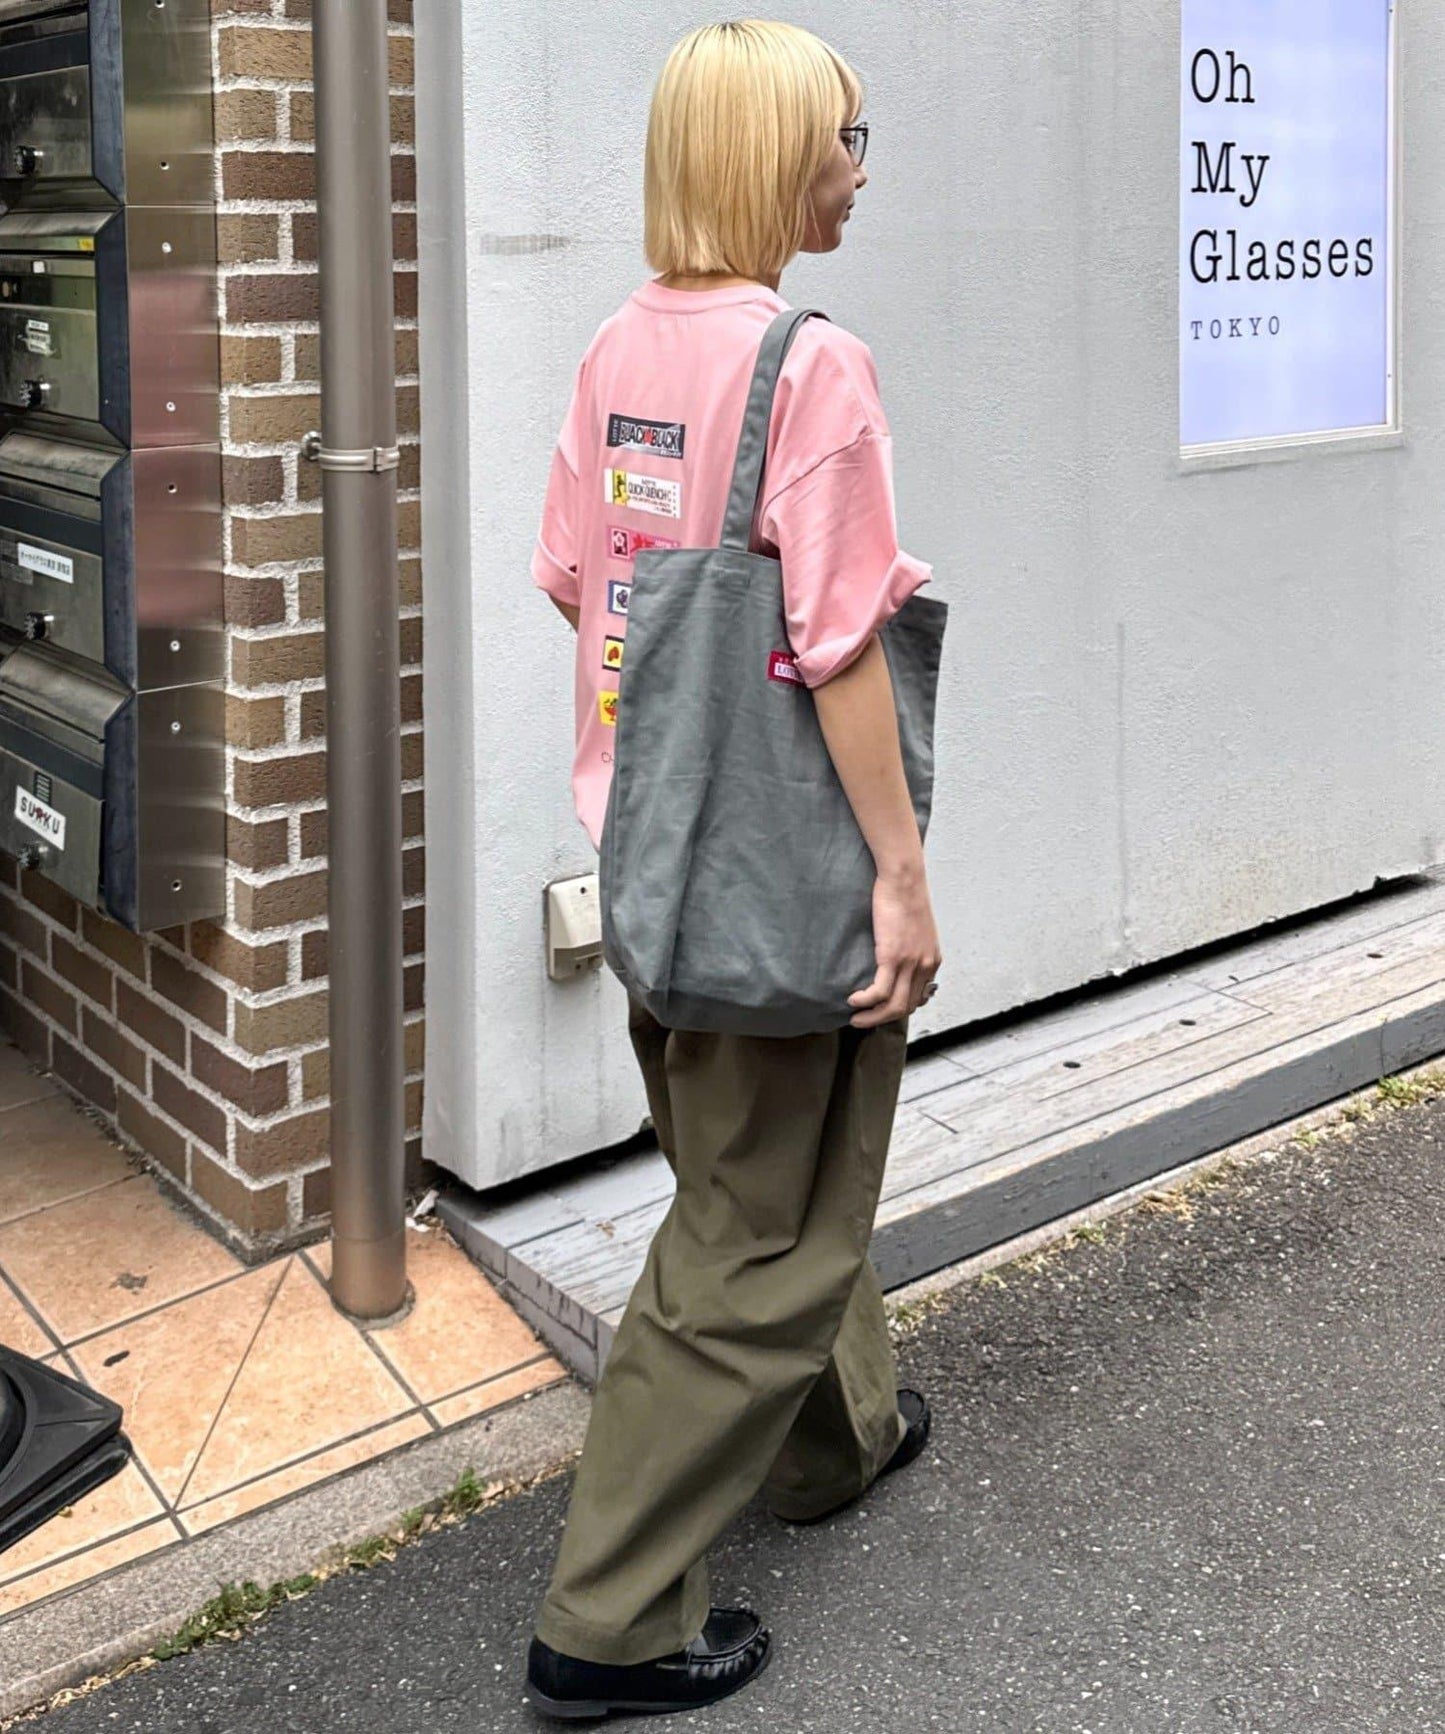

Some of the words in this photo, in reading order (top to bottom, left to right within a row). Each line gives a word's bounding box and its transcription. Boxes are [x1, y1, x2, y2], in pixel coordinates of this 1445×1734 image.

[1190, 48, 1255, 103] Oh
[1190, 141, 1270, 208] My
[1190, 229, 1374, 283] Glasses
[1190, 315, 1280, 340] TOKYO
